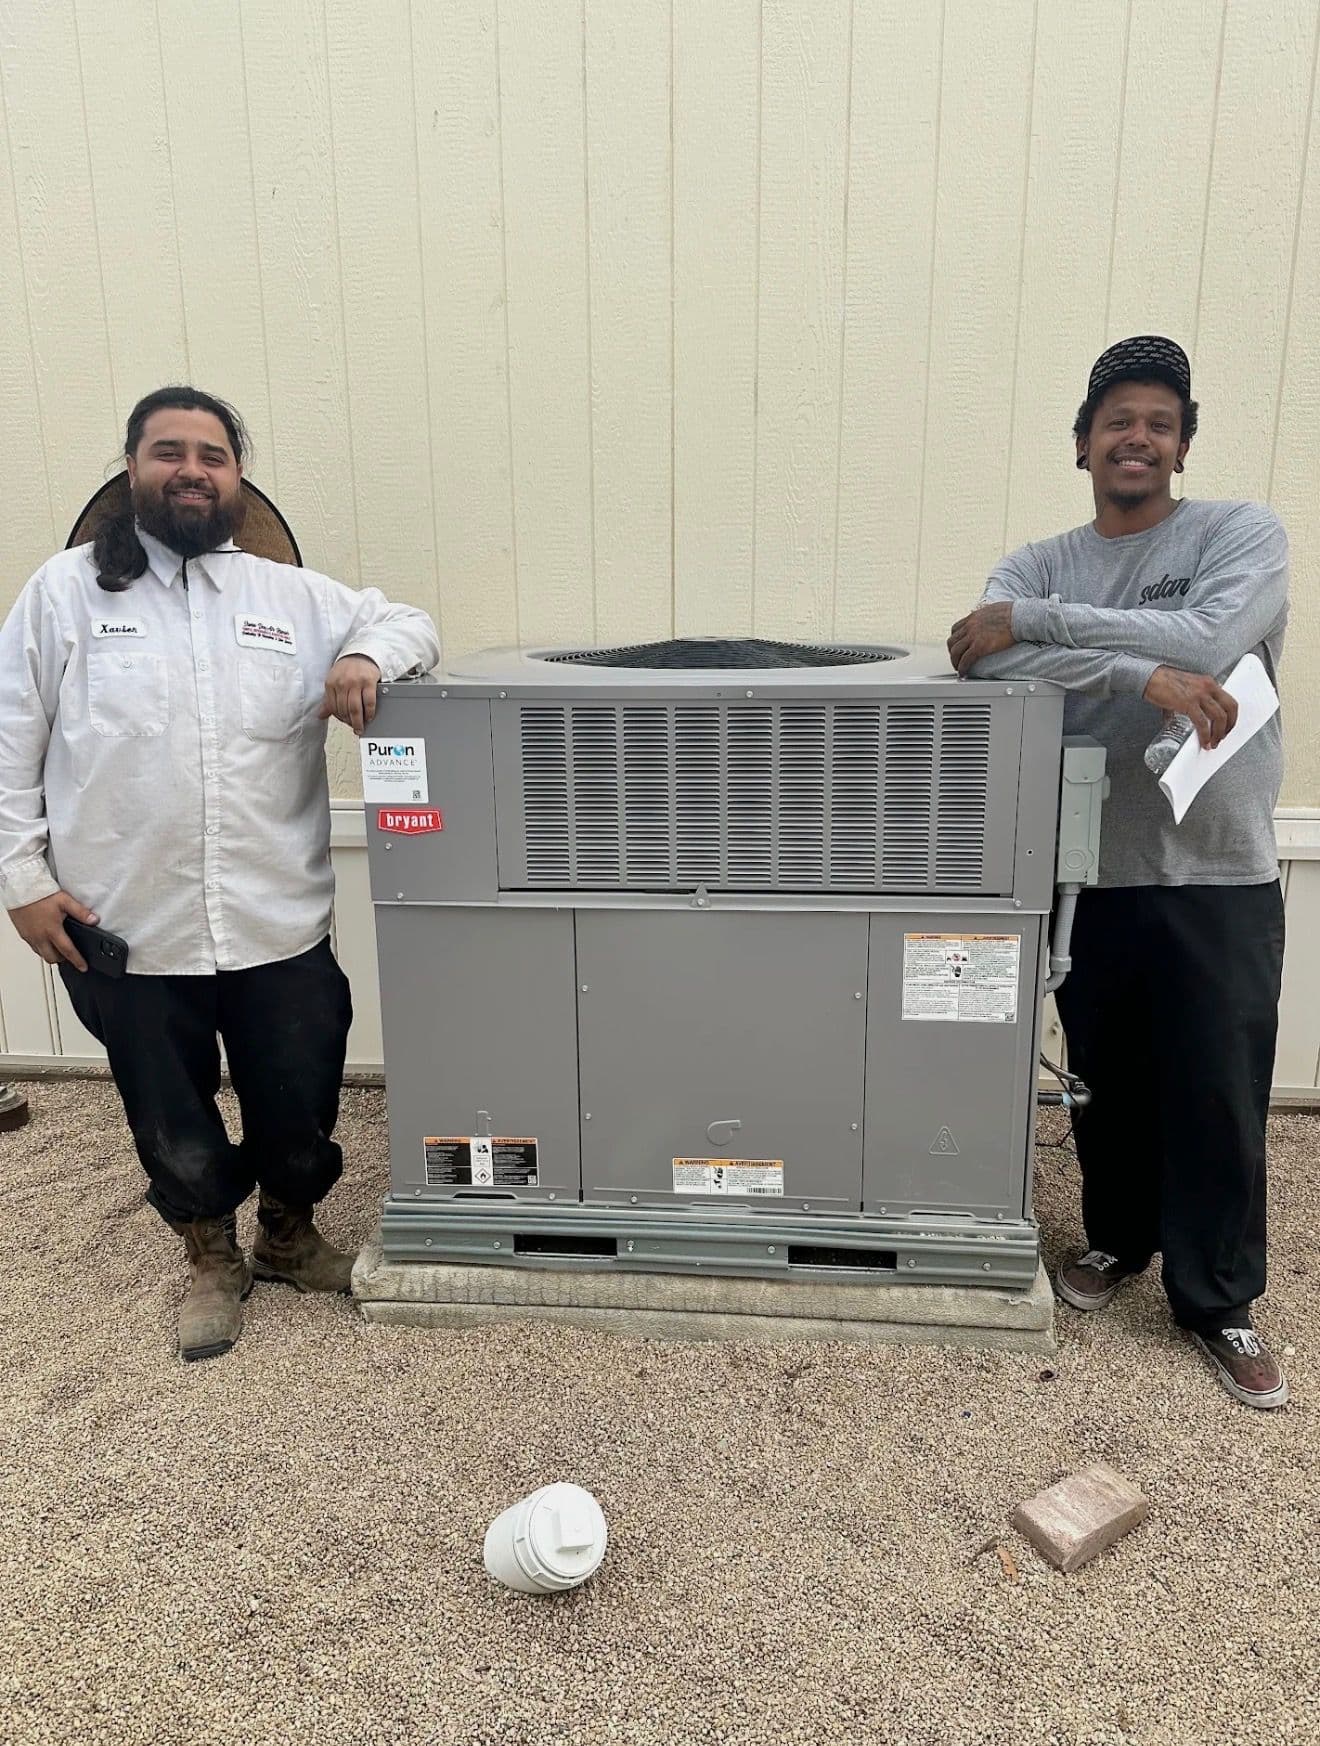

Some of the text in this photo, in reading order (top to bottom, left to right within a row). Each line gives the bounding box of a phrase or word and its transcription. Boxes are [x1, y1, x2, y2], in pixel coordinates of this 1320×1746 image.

[100, 624, 138, 633] Xavier
[368, 742, 415, 756] Puron
[386, 813, 434, 829] bryant
